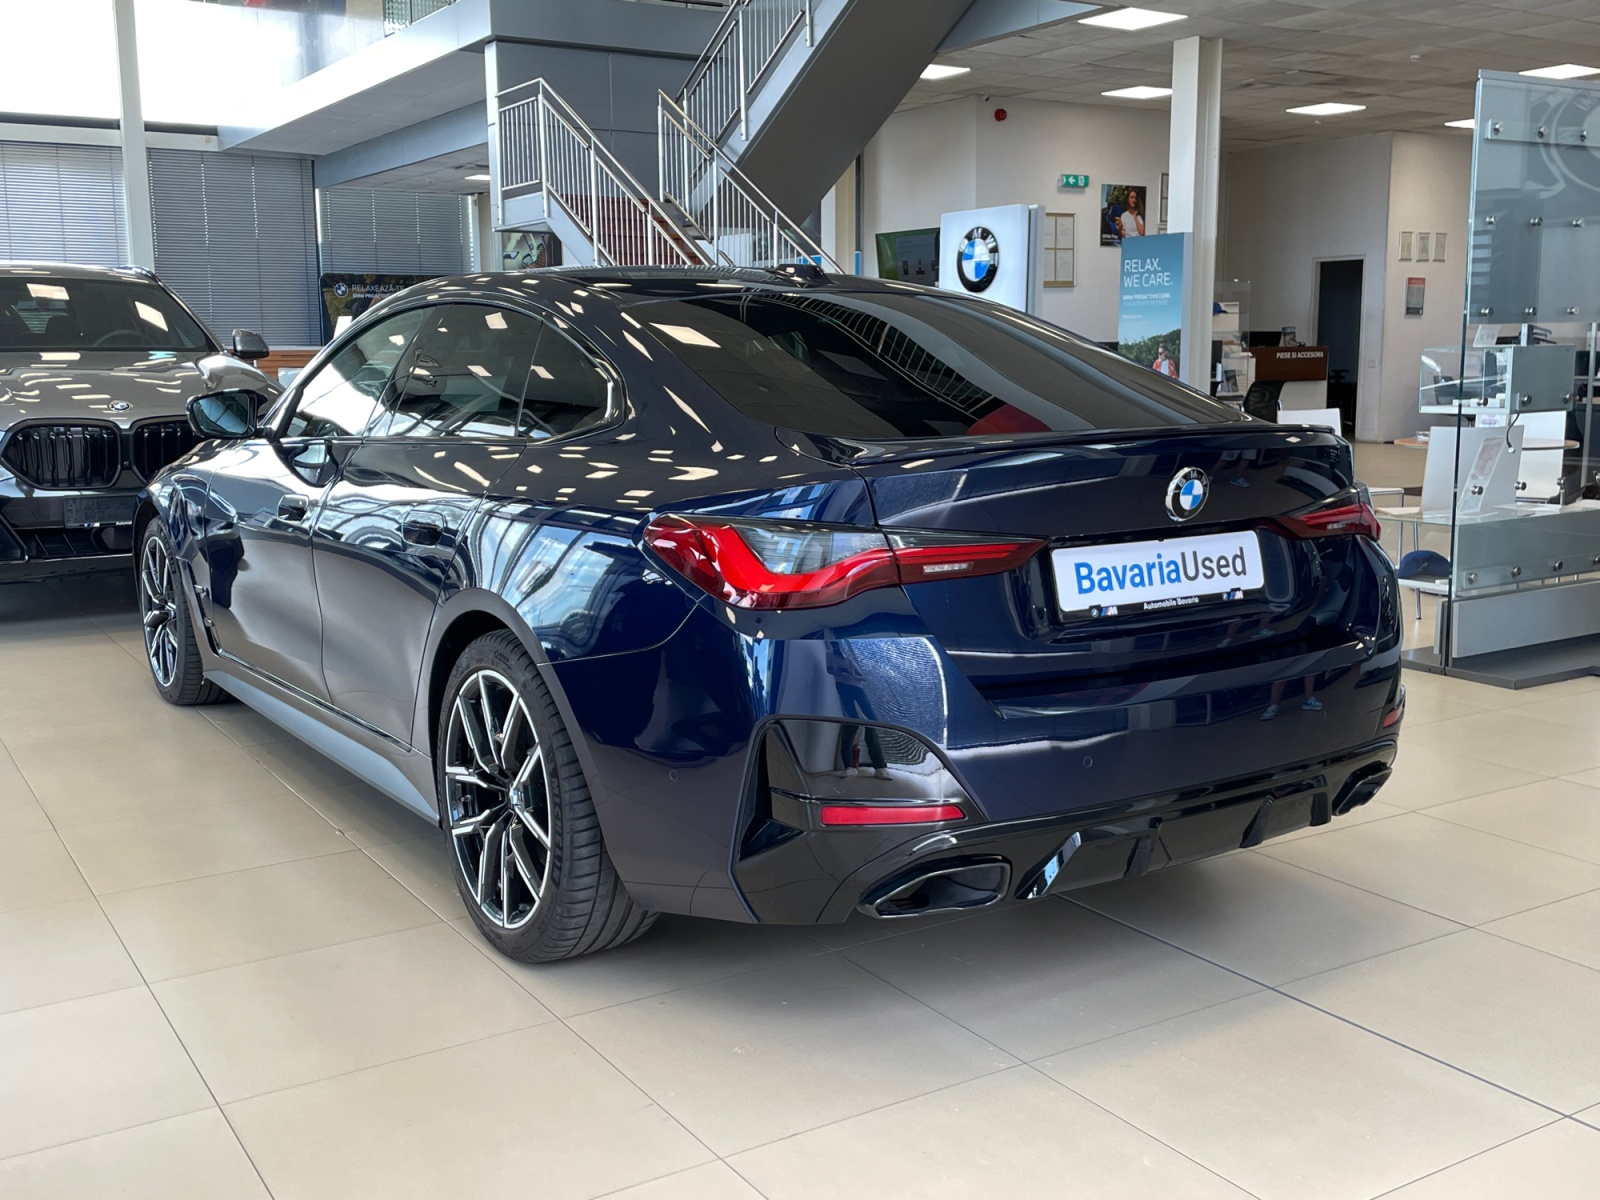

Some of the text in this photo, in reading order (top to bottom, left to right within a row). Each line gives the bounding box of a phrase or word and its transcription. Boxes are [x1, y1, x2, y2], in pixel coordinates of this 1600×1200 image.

[1124, 258, 1161, 273] RELAX.
[1123, 272, 1173, 288] WE CARE.
[1074, 546, 1247, 595] BavariaUsed
[1143, 596, 1200, 610] Automobile Bavaria
